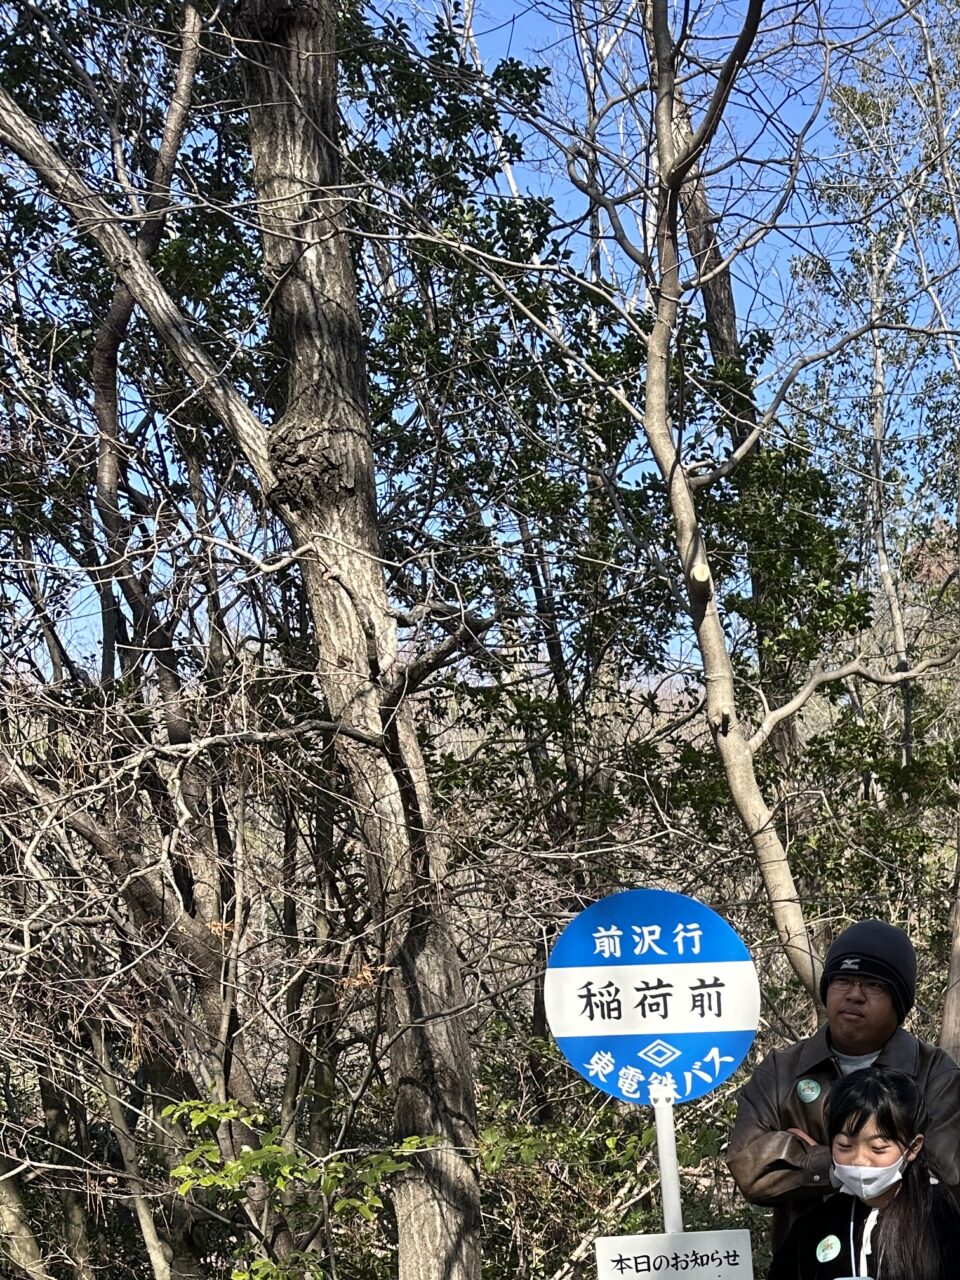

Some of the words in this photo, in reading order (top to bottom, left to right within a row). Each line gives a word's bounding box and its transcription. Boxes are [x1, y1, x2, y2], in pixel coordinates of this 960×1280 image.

[592, 922, 703, 958] 前沢行
[577, 976, 725, 1021] 稲荷前
[610, 1249, 740, 1275] 本日のお知らせ
